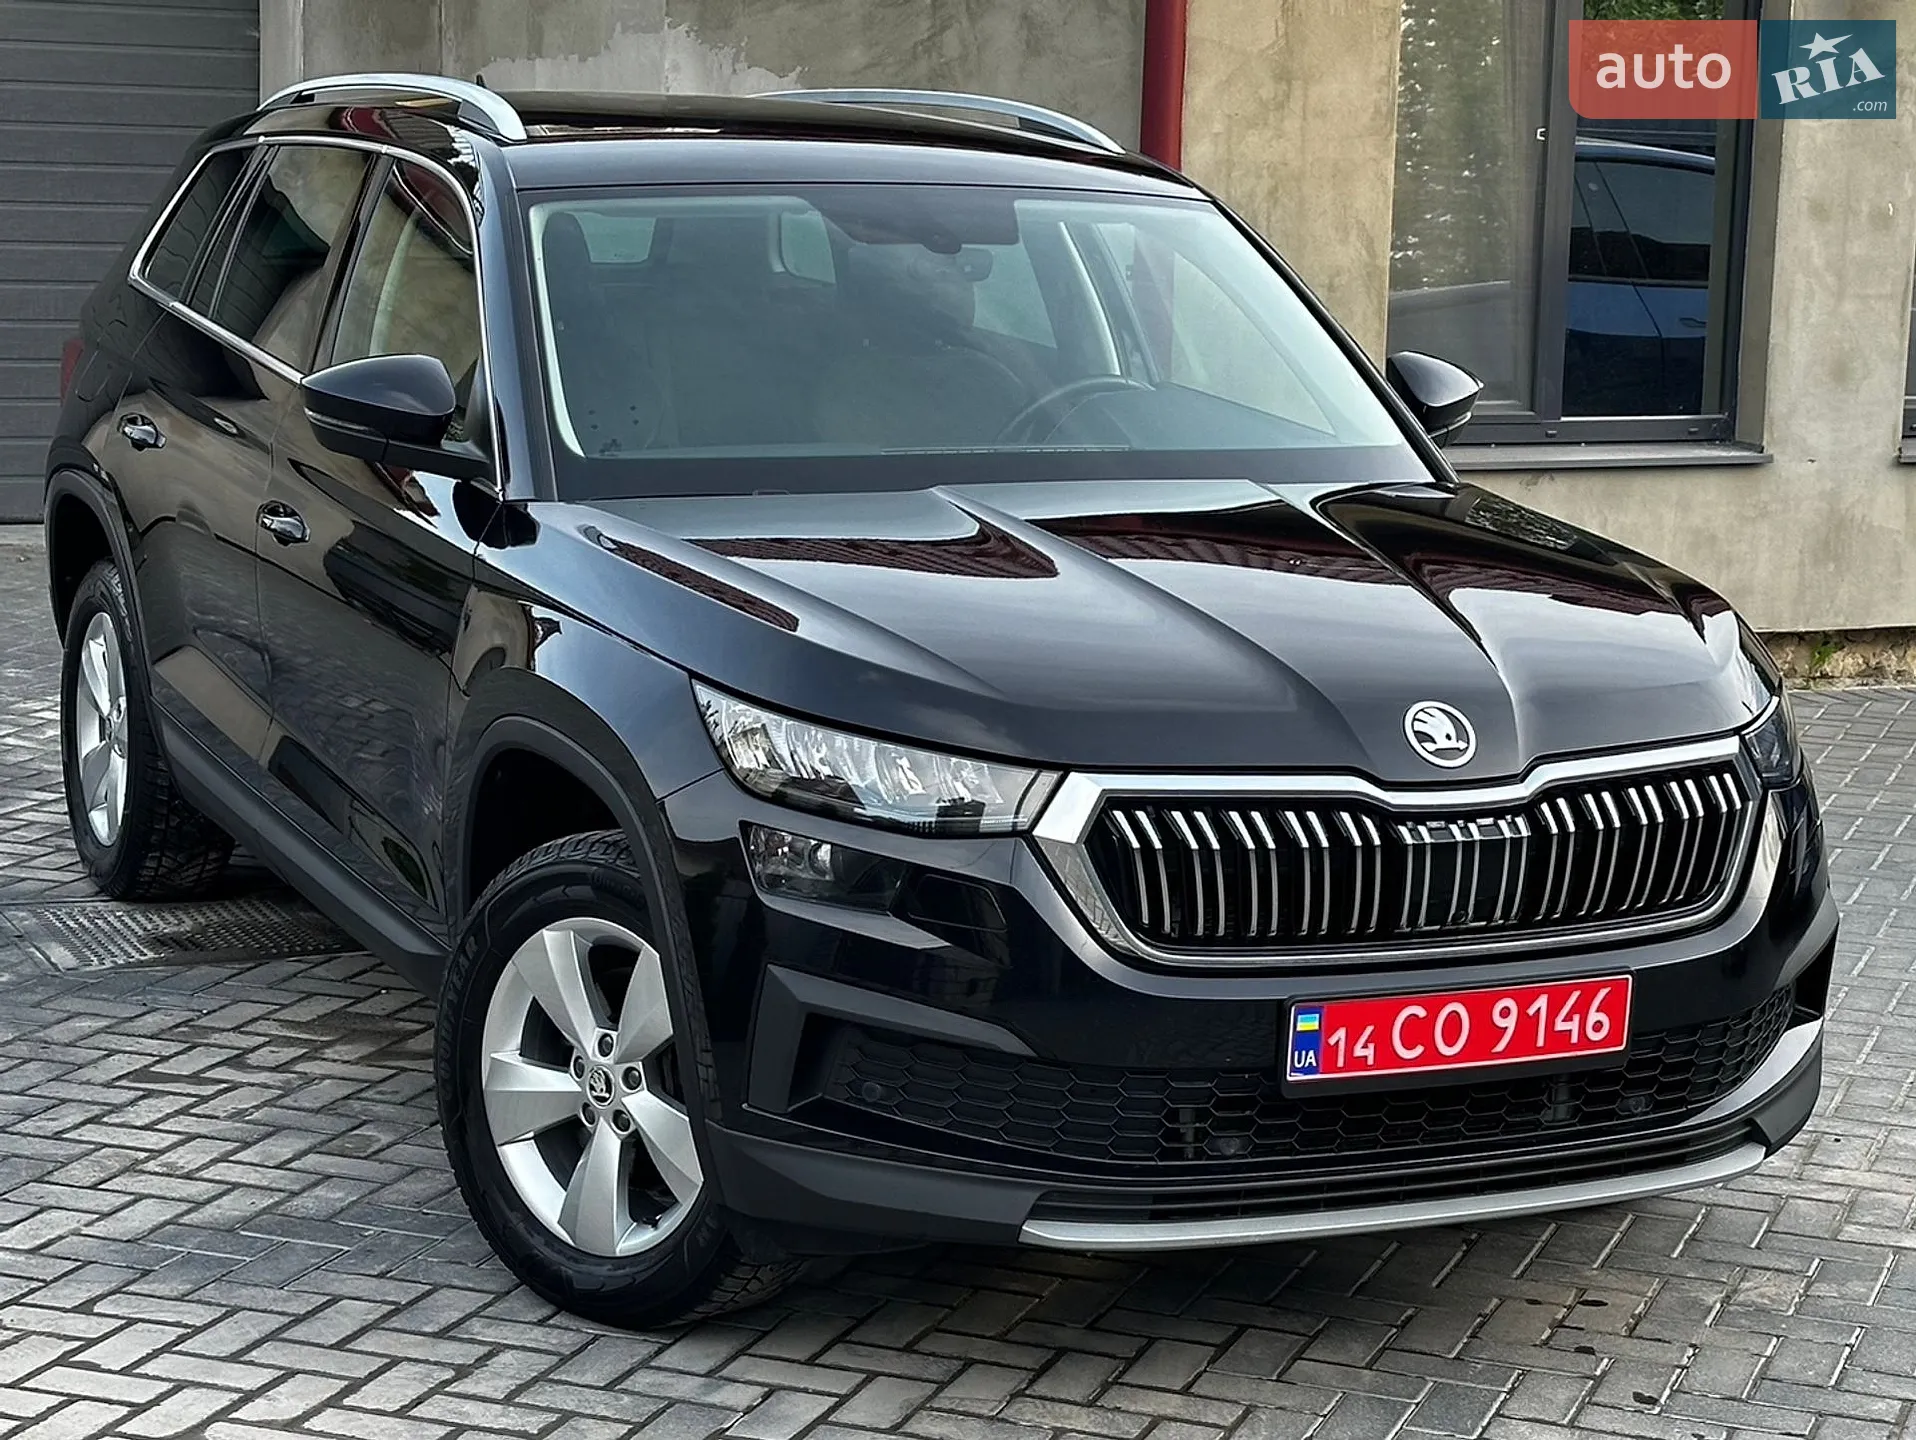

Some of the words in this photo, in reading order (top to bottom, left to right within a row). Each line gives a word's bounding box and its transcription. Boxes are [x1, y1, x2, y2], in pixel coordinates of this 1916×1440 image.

[1327, 1024, 1376, 1068] 14
[1391, 1001, 1471, 1060] CO
[1491, 986, 1613, 1053] 9146
[1294, 1051, 1318, 1068] UA
